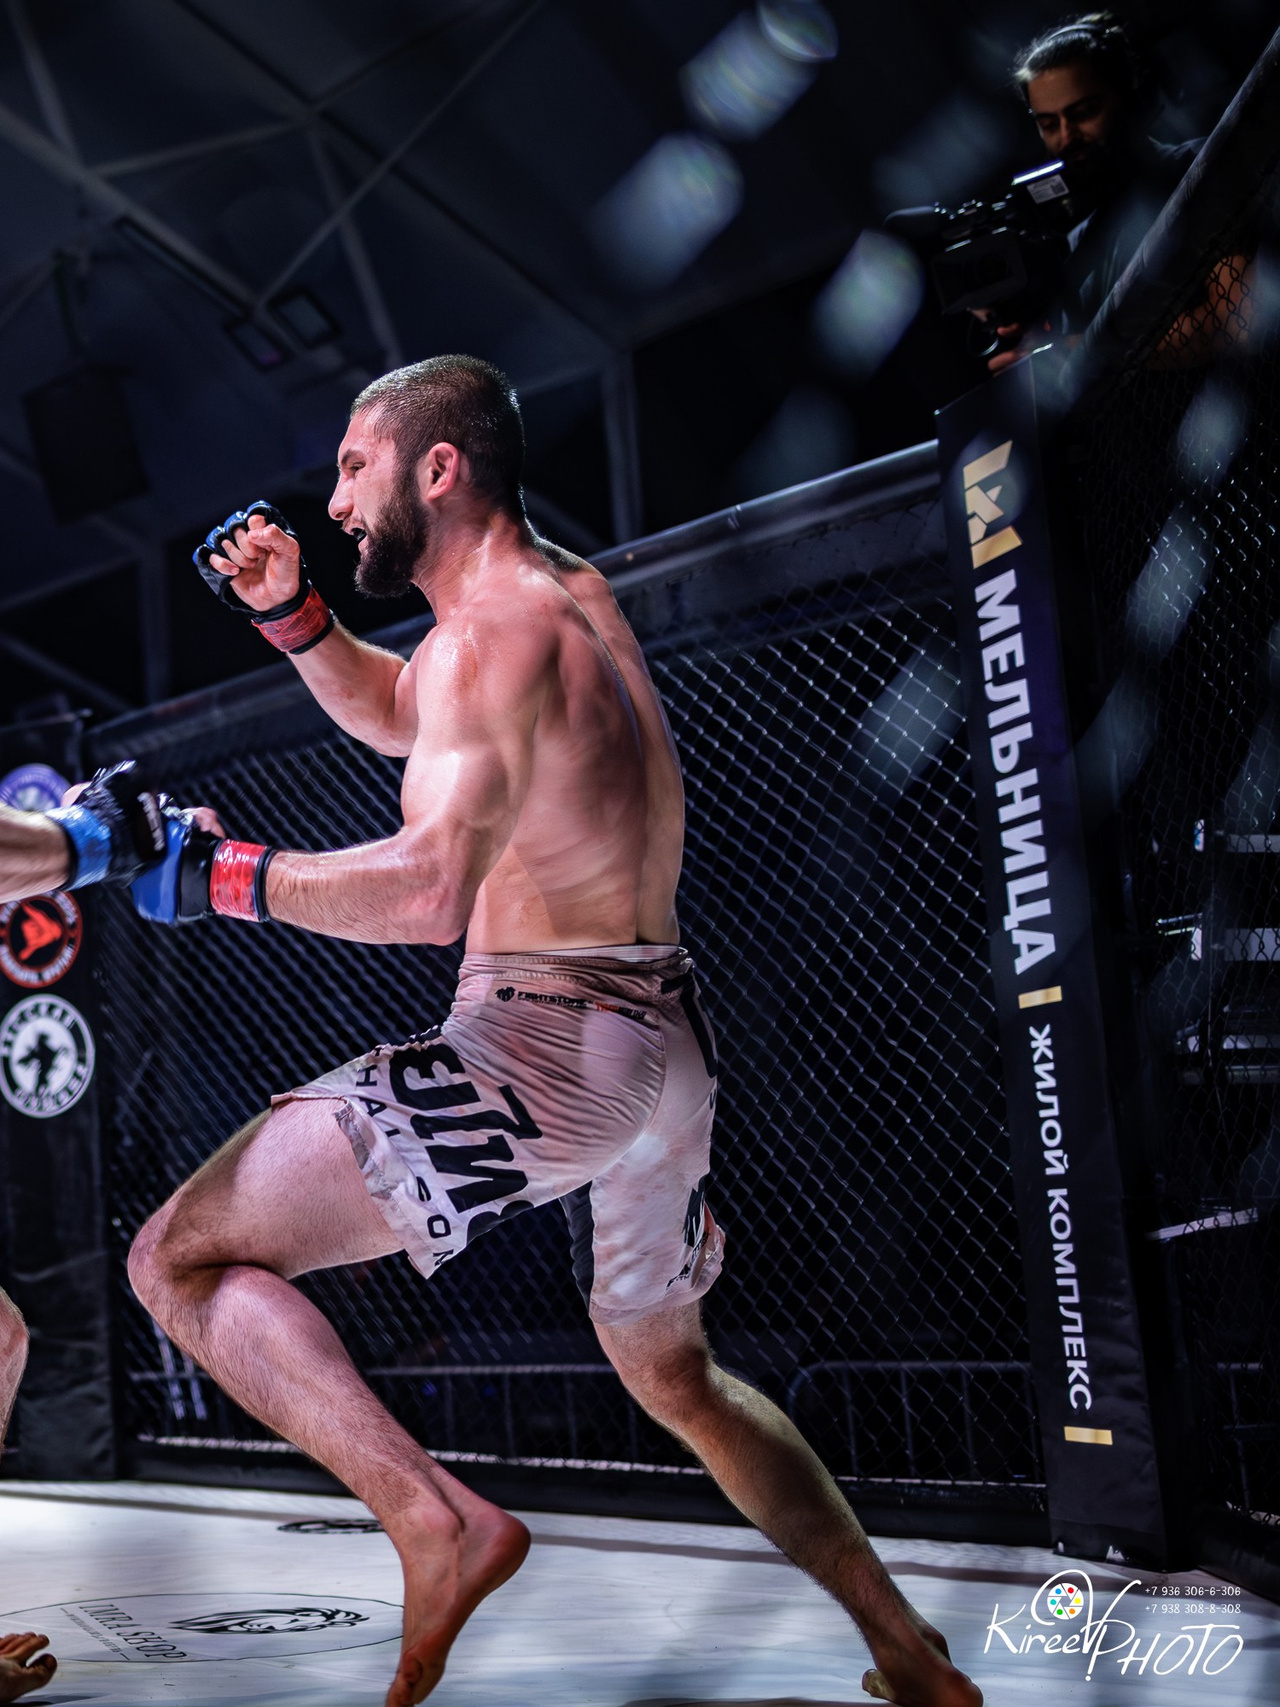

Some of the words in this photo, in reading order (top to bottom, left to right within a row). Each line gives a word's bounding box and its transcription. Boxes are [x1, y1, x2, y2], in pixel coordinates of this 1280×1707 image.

[974, 568, 1056, 976] МЕЛЬНИЦА
[1028, 1022, 1070, 1177] ЖИЛОЙ
[1046, 1187, 1092, 1411] КОМПЛЕКС
[116, 1631, 188, 1658] SHOP
